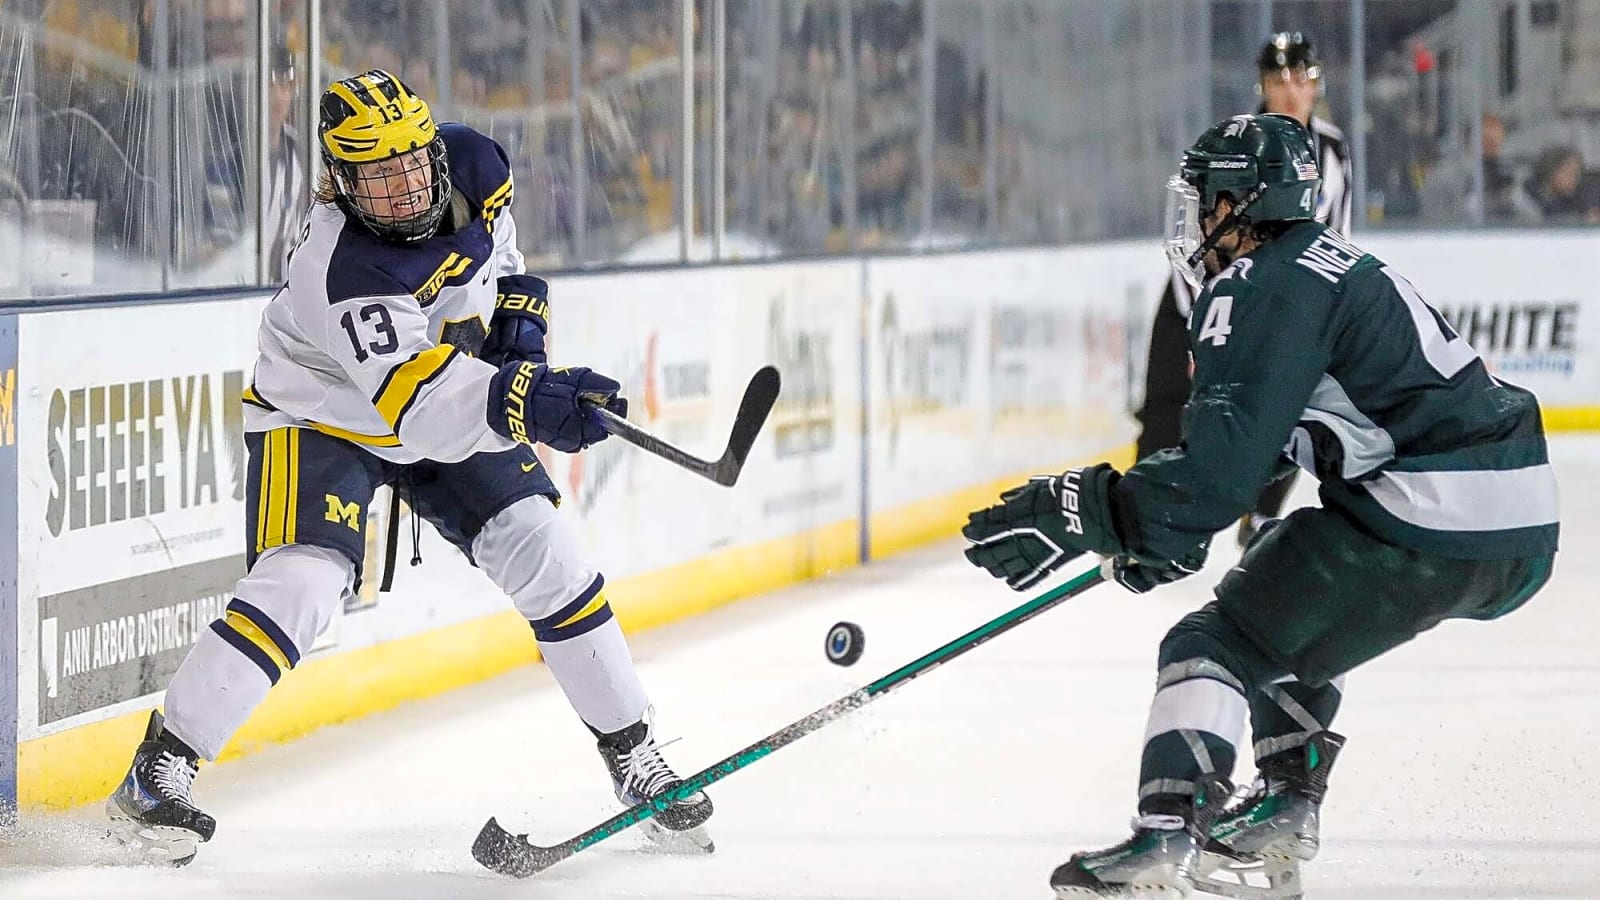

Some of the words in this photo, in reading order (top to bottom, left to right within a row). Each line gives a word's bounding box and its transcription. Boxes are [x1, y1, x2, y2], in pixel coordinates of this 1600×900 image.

[378, 104, 403, 124] 13
[1300, 188, 1312, 211] 4
[340, 303, 400, 363] 13
[1198, 296, 1234, 346] 4
[46, 379, 165, 538] SEEEEE
[172, 373, 218, 509] YA
[325, 494, 360, 533] M
[1061, 467, 1084, 535] UER
[63, 626, 90, 677] ANN
[93, 615, 136, 669] ARBOR
[138, 602, 190, 657] DISTRICT
